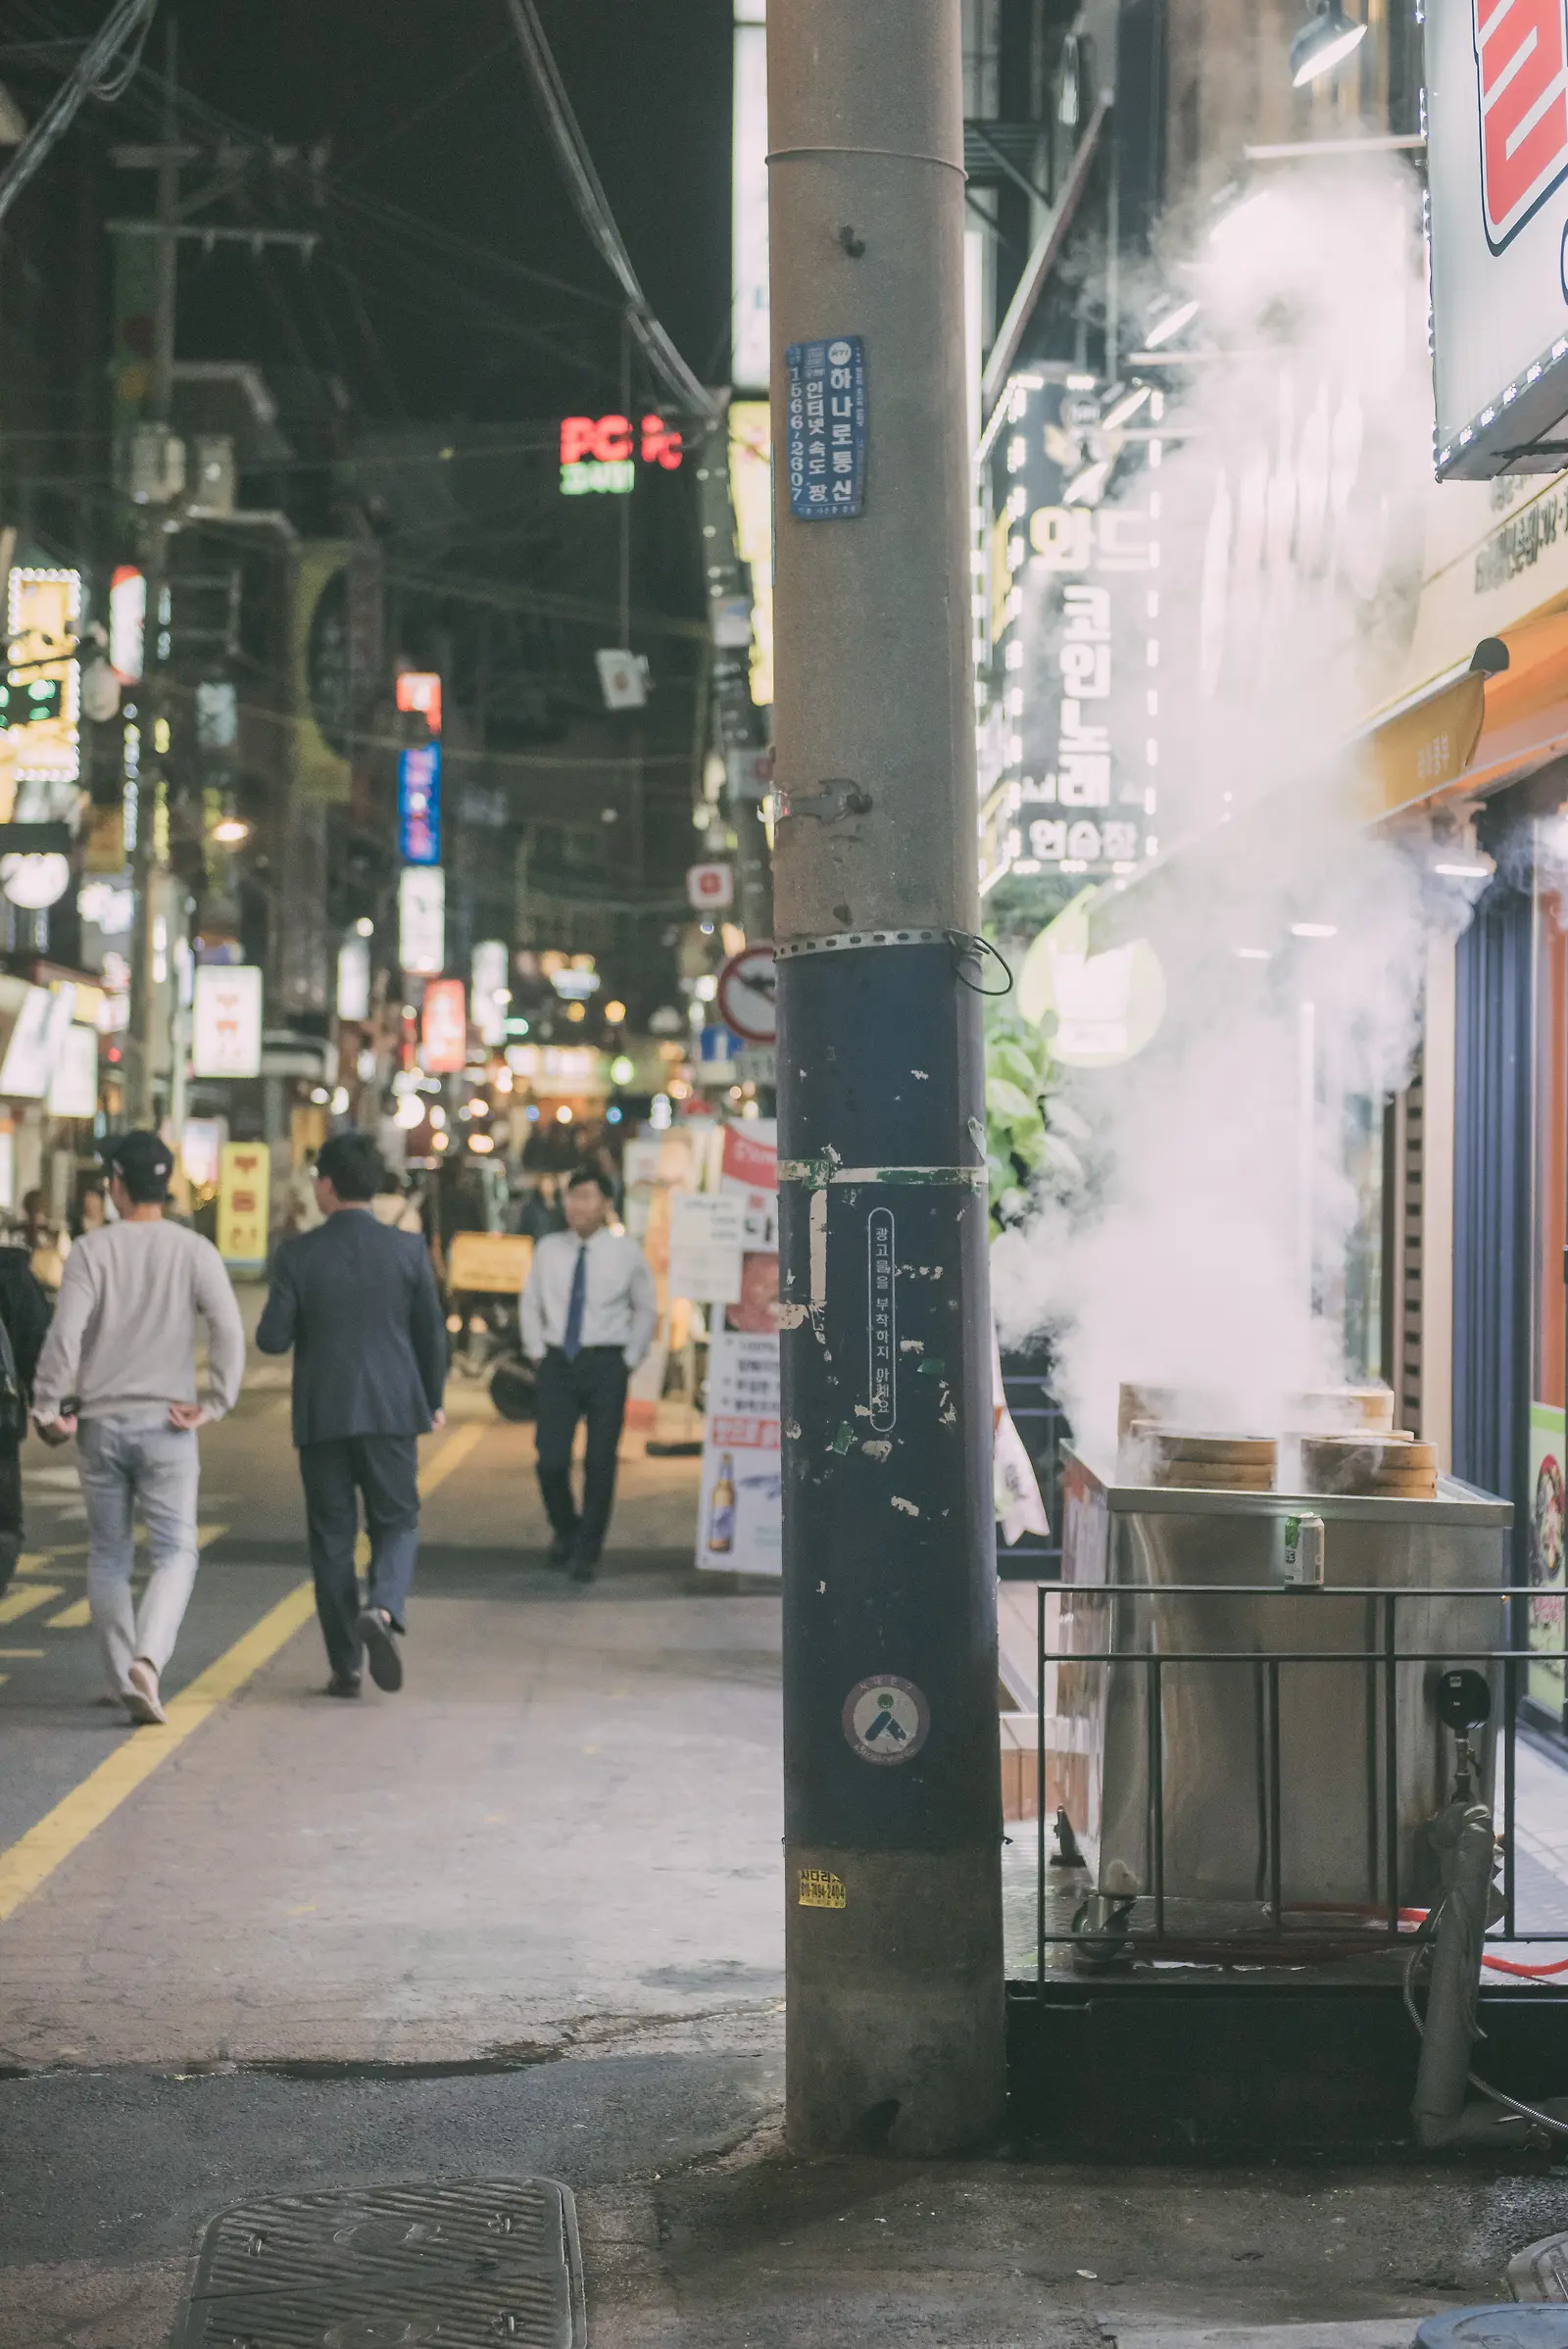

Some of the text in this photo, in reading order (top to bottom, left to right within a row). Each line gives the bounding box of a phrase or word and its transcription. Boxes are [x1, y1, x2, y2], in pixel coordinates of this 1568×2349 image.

[807, 380, 825, 435] 인터넷
[830, 367, 854, 502] 하나로통신
[808, 440, 826, 475] 속도
[875, 1227, 890, 1290] 광고물을
[876, 1297, 890, 1360] 부착하지
